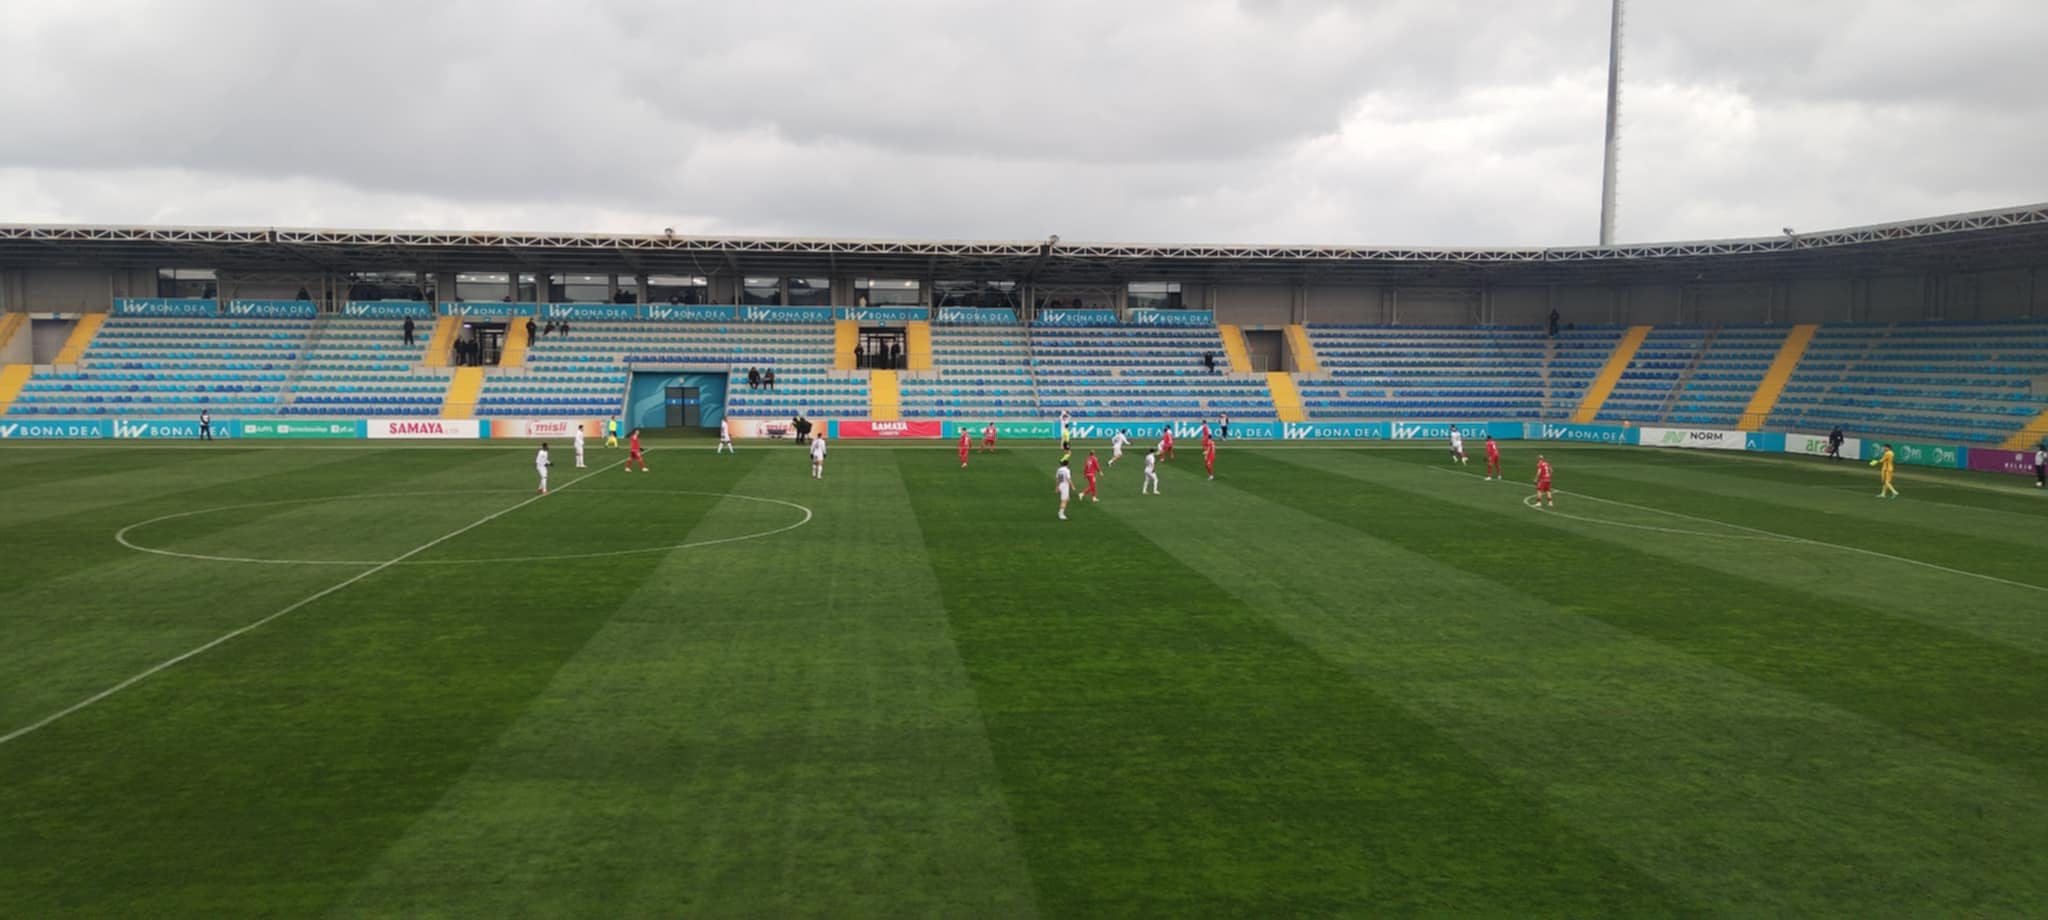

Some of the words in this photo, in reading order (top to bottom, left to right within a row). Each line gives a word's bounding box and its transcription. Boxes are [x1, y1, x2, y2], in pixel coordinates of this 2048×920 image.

[150, 304, 179, 313] BONA
[184, 305, 205, 313] DEA
[257, 306, 284, 314] BONA
[290, 306, 311, 314] DEA
[701, 311, 725, 319] DEA
[772, 312, 799, 320] BONA
[803, 312, 822, 320] DEA
[960, 313, 986, 321] BONA
[1067, 315, 1092, 323] BONA
[1096, 315, 1115, 323] DEA
[389, 422, 443, 434] SAMAYA
[536, 422, 567, 432] misli
[21, 427, 63, 436] BONA
[69, 427, 100, 437] DEA
[151, 427, 192, 437] BONA
[1138, 428, 1164, 437] DEA
[1209, 428, 1241, 438] ONA
[1247, 429, 1272, 438] DEA
[1315, 429, 1350, 438] BONA
[1355, 429, 1379, 439] DEA
[1461, 429, 1486, 438] DEA
[1690, 432, 1723, 441] NORM
[1603, 432, 1625, 442] DEA
